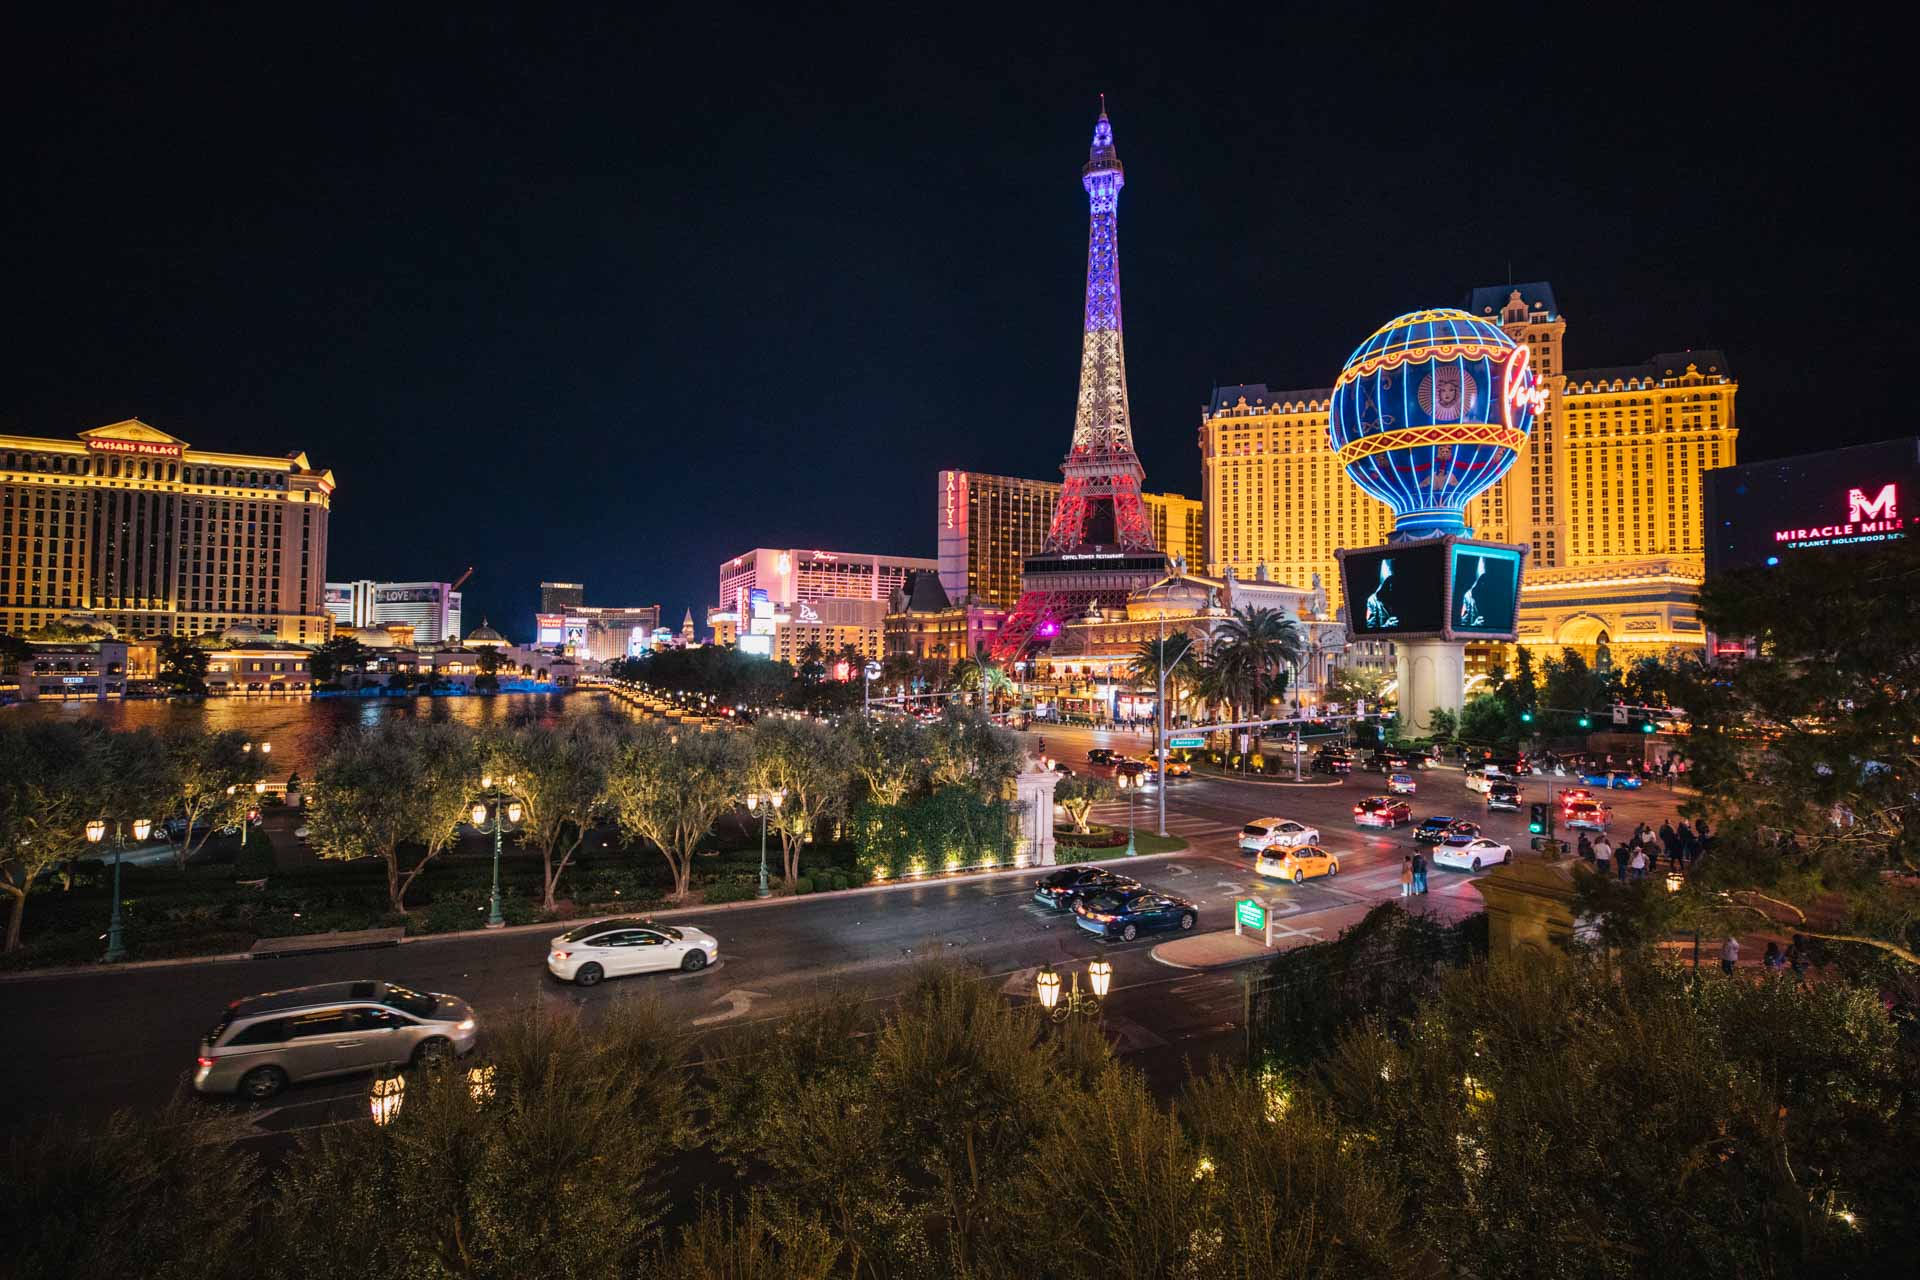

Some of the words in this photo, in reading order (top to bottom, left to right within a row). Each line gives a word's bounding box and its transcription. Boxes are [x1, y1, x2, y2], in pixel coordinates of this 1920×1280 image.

[90, 441, 136, 451] CAESARS
[138, 445, 178, 455] PALACE
[1849, 484, 1896, 522] M
[1776, 525, 1853, 541] MIRACLE
[1831, 534, 1885, 544] HOLLYWOOD
[386, 591, 409, 601] LOVE
